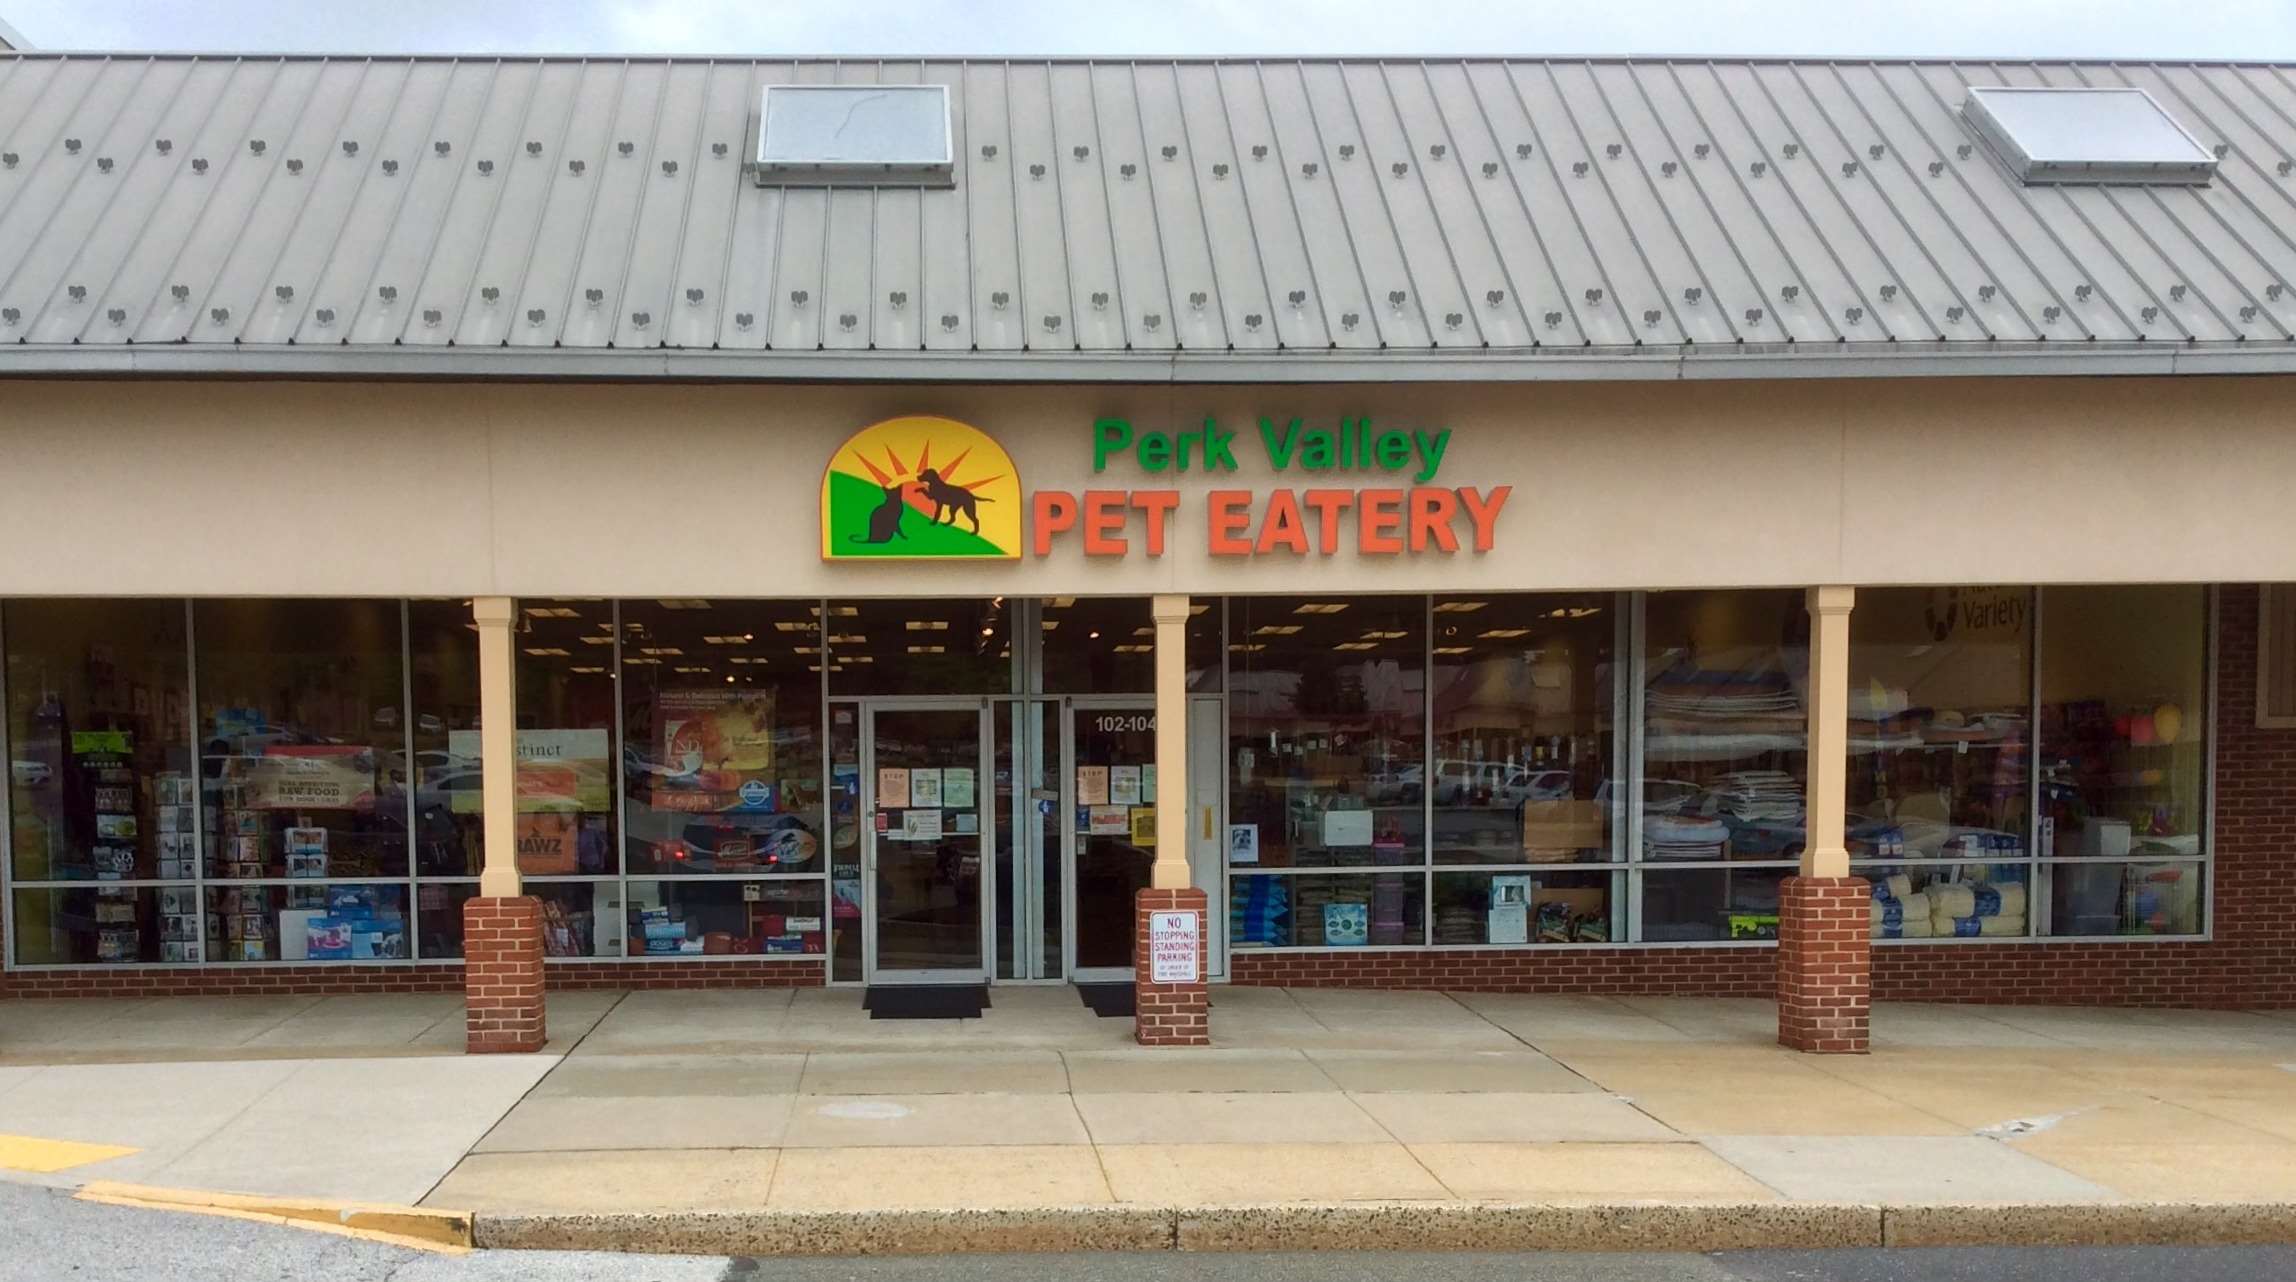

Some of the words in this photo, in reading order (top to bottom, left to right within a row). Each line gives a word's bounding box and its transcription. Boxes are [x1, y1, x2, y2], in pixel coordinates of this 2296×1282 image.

[1093, 416, 1238, 473] Perk
[1257, 415, 1452, 483] Valley
[1032, 489, 1181, 557] PET
[1207, 485, 1513, 556] EATERY
[1963, 594, 2026, 633] Variety
[1095, 715, 1157, 732] 102-104
[515, 744, 561, 757] stinct
[308, 787, 340, 797] FOOD
[1167, 917, 1182, 929] NO
[1155, 931, 1195, 941] STOPPING
[1155, 941, 1195, 952] STANDING
[1157, 952, 1193, 963] PARKING
